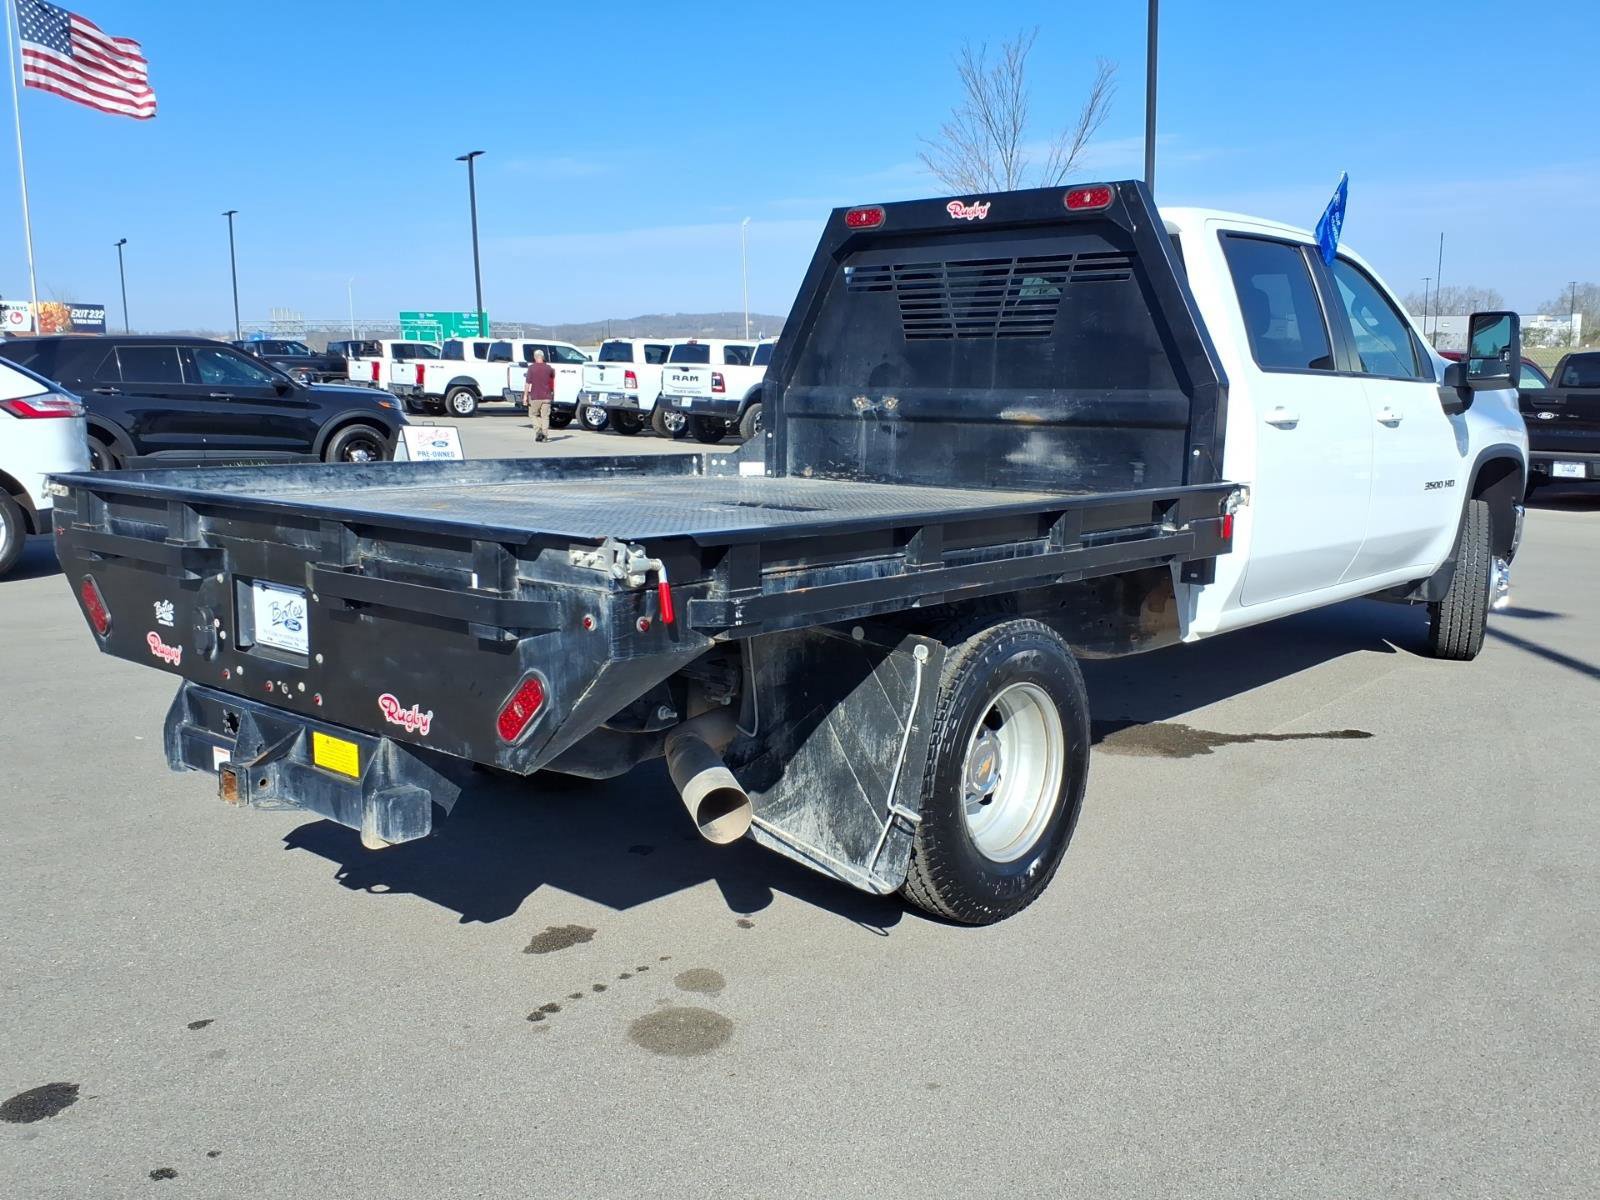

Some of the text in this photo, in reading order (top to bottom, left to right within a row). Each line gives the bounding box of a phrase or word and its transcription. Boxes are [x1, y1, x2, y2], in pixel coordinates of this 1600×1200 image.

[947, 201, 990, 220] Rugby
[71, 308, 105, 319] EXIT 232
[1424, 480, 1455, 491] 3500 HD
[147, 631, 182, 666] Rugby
[378, 693, 433, 735] Rugby
